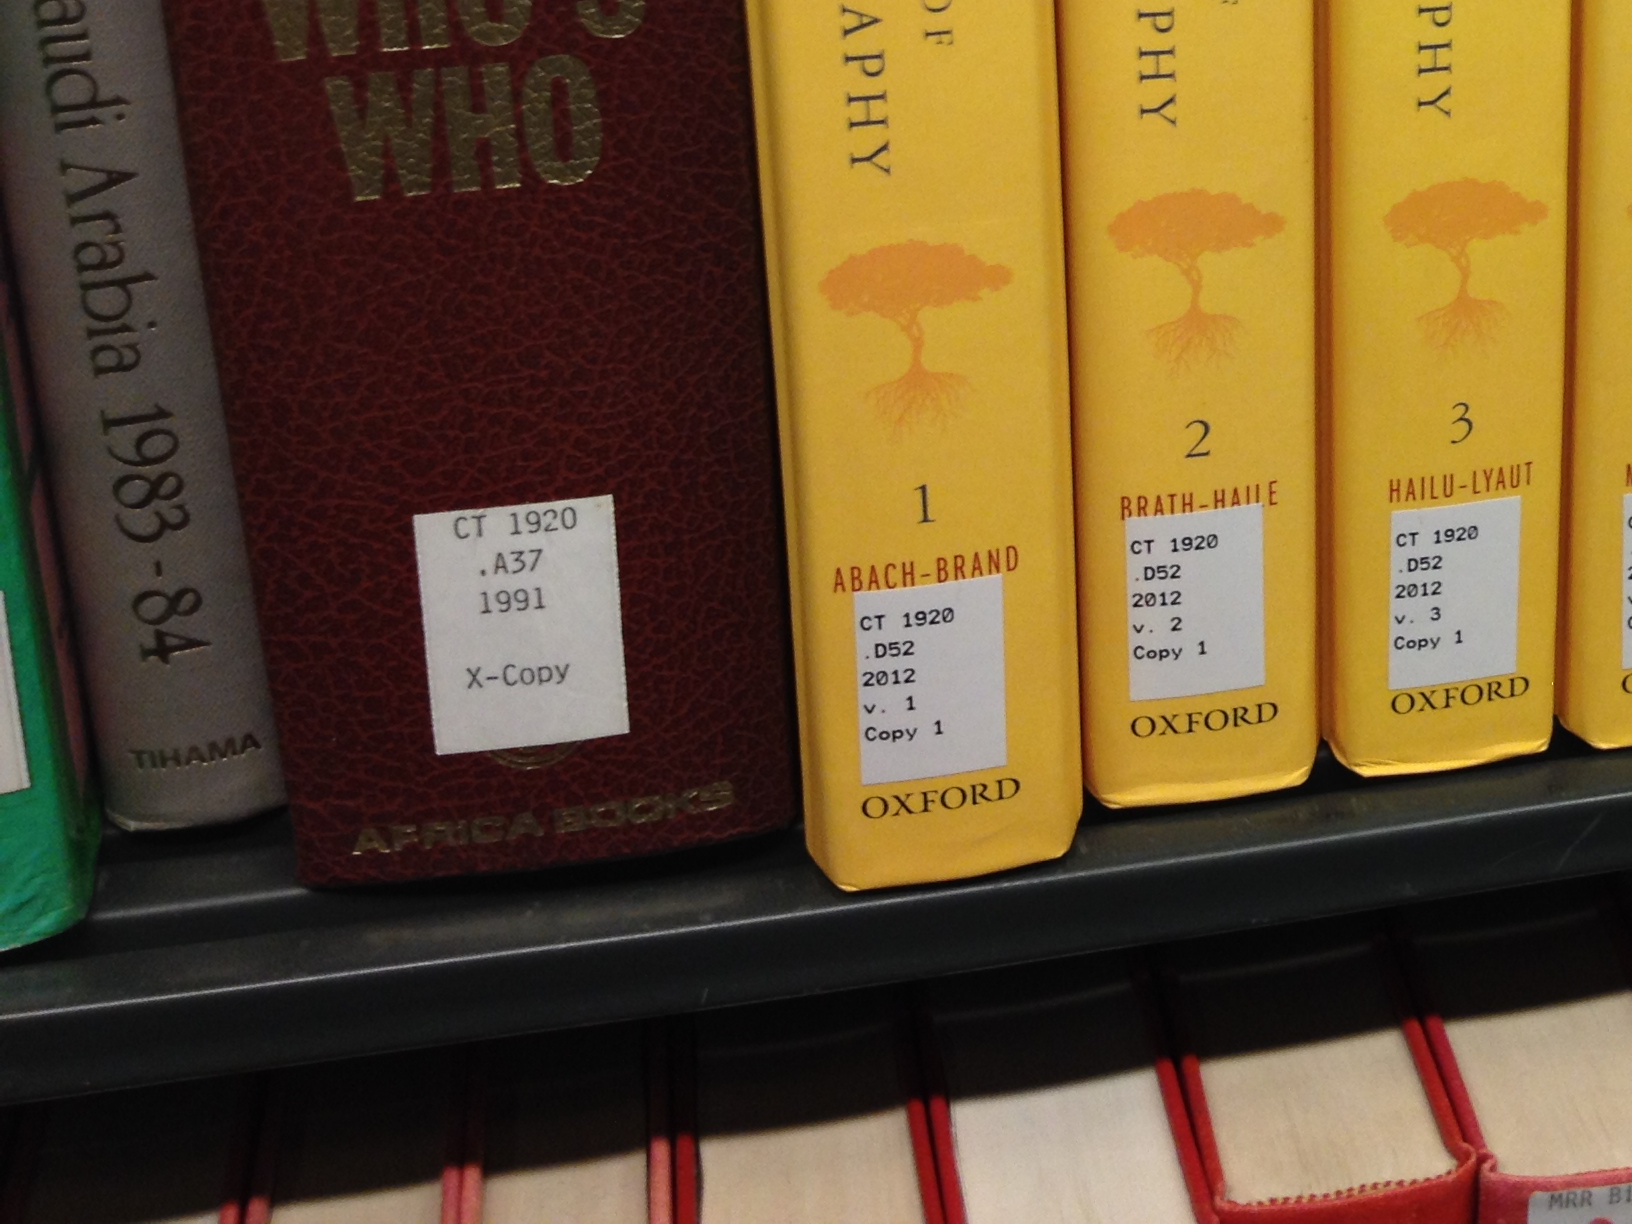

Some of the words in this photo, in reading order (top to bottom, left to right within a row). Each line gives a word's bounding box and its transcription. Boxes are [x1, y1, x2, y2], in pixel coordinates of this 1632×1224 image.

[323, 53, 602, 202] WHO
[59, 159, 159, 379] Arabia
[1450, 402, 1474, 444] 3
[1185, 419, 1212, 459] 2
[1389, 461, 1533, 503] HAILU-LYAUT
[914, 484, 936, 524] 1
[453, 515, 488, 539] CT
[509, 506, 578, 536] 1920
[1131, 538, 1154, 556] CT
[1170, 534, 1219, 553] 1920
[1395, 532, 1419, 548] CT
[1433, 525, 1478, 544] 1920
[478, 549, 544, 578] .A37
[833, 545, 1020, 594] ABACH-BRAND
[1134, 564, 1181, 581] .D52
[1399, 556, 1443, 574] .D52
[477, 588, 546, 615] 1991
[1132, 591, 1182, 608] 2012
[1394, 582, 1442, 599] 2012
[859, 614, 886, 631] CT
[902, 607, 955, 628] 1920
[1170, 617, 1182, 632] 2
[1430, 607, 1441, 622] 3
[865, 641, 915, 660] .D52
[1133, 644, 1182, 661] Copy
[1394, 635, 1441, 652] Copy
[466, 660, 570, 691] X-Copy
[862, 668, 916, 688] 2012
[906, 696, 916, 712] 1
[1391, 675, 1530, 716] OXFORD
[865, 724, 917, 743] Copy
[934, 721, 944, 736] 1
[1130, 701, 1279, 739] OXFORD
[129, 732, 262, 773] TIHAMA
[861, 777, 1022, 820] OXFORD
[352, 811, 544, 855] AFRICA
[554, 781, 735, 834] BOOKS
[1549, 1190, 1594, 1210] MRR
